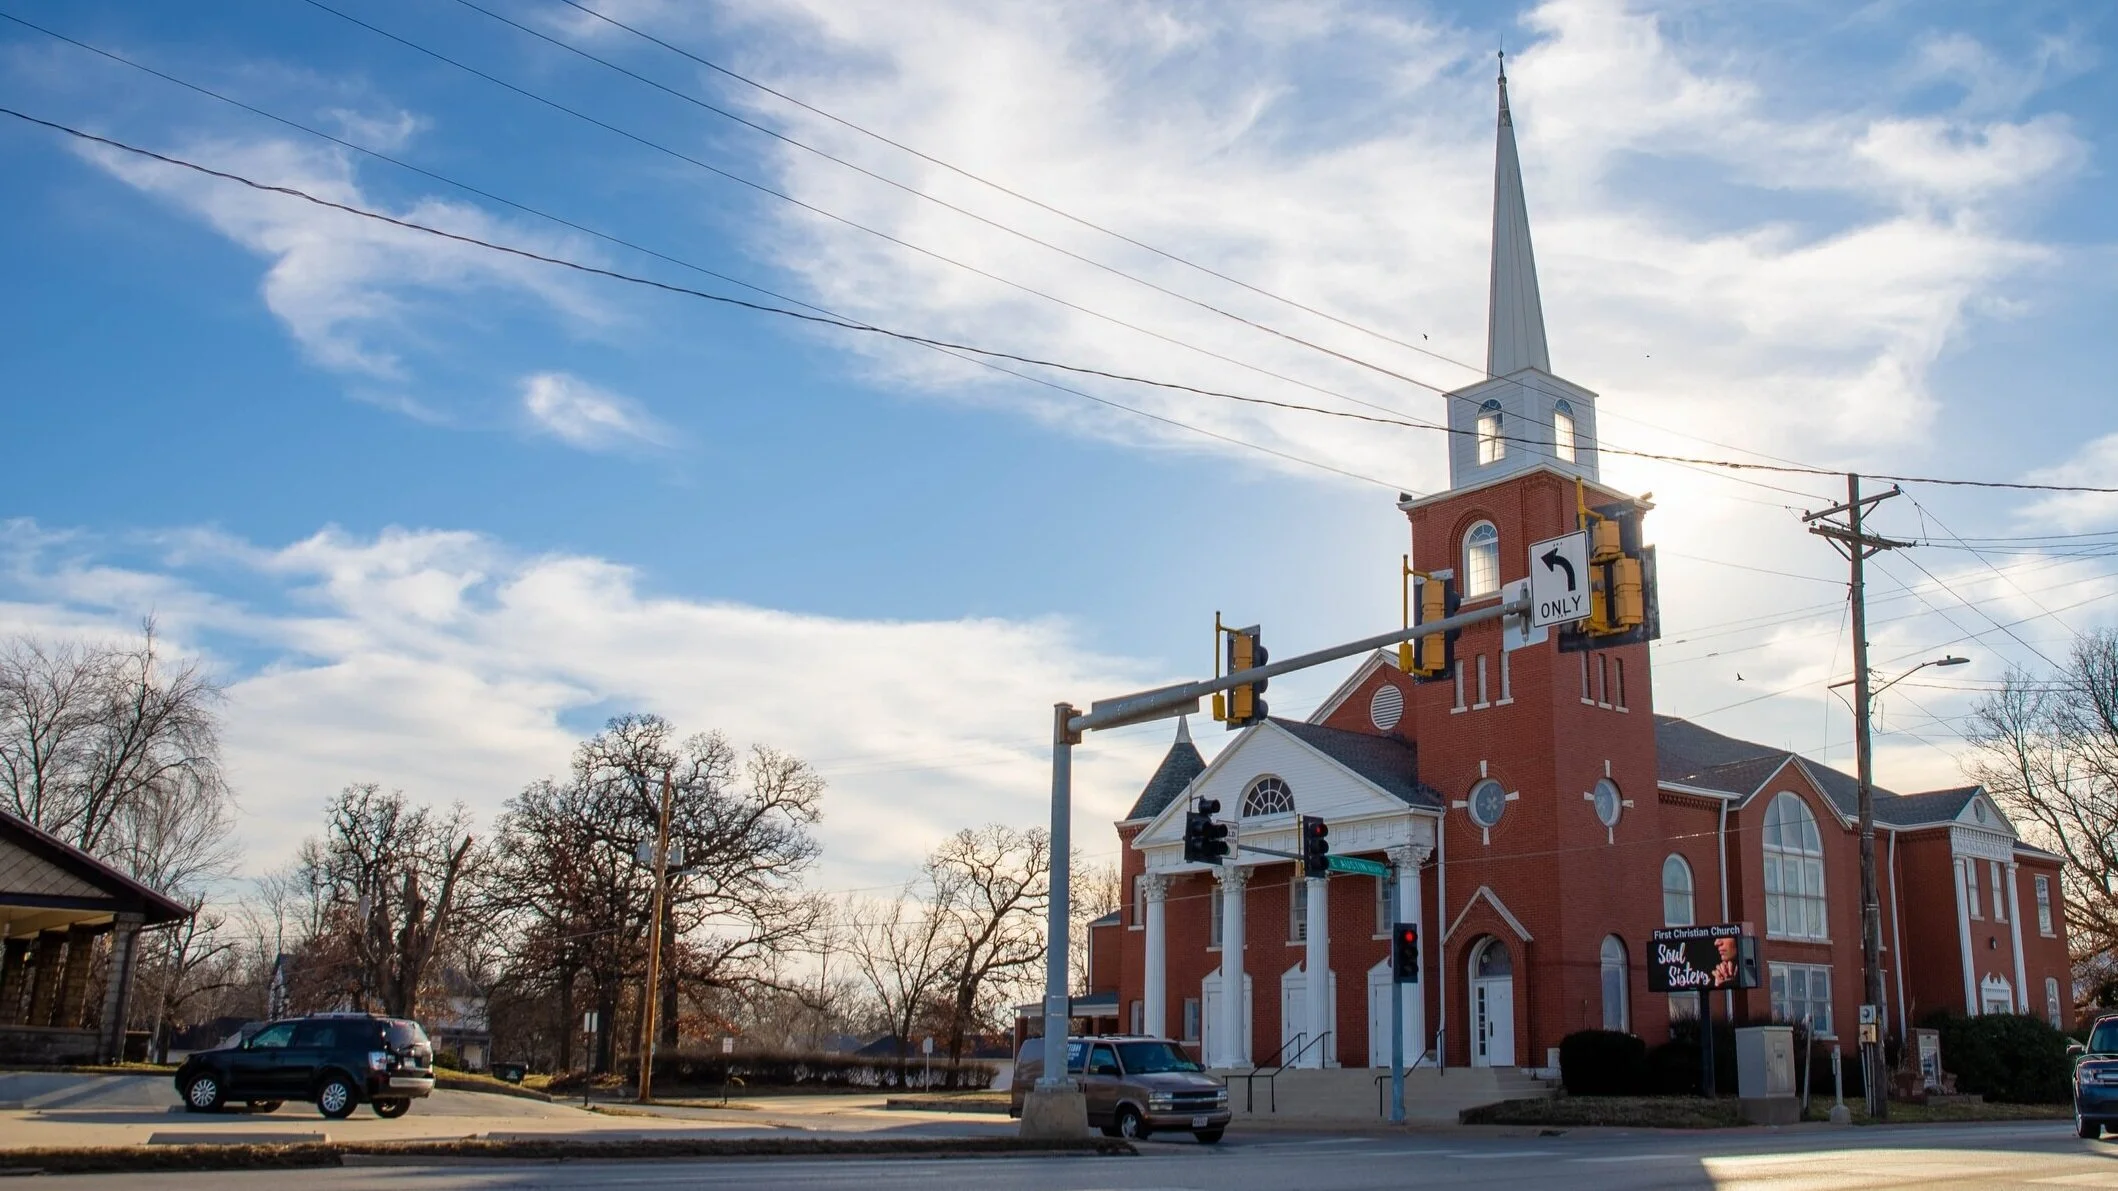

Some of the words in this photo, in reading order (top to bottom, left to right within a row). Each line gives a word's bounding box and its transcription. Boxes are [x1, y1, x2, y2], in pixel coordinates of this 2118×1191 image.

[1541, 595, 1581, 618] ONLY
[1654, 930, 1672, 940] First
[1674, 928, 1709, 938] Christian
[1711, 925, 1740, 936] Church
[1658, 942, 1686, 965] Soul
[1668, 962, 1711, 987] Sisters
